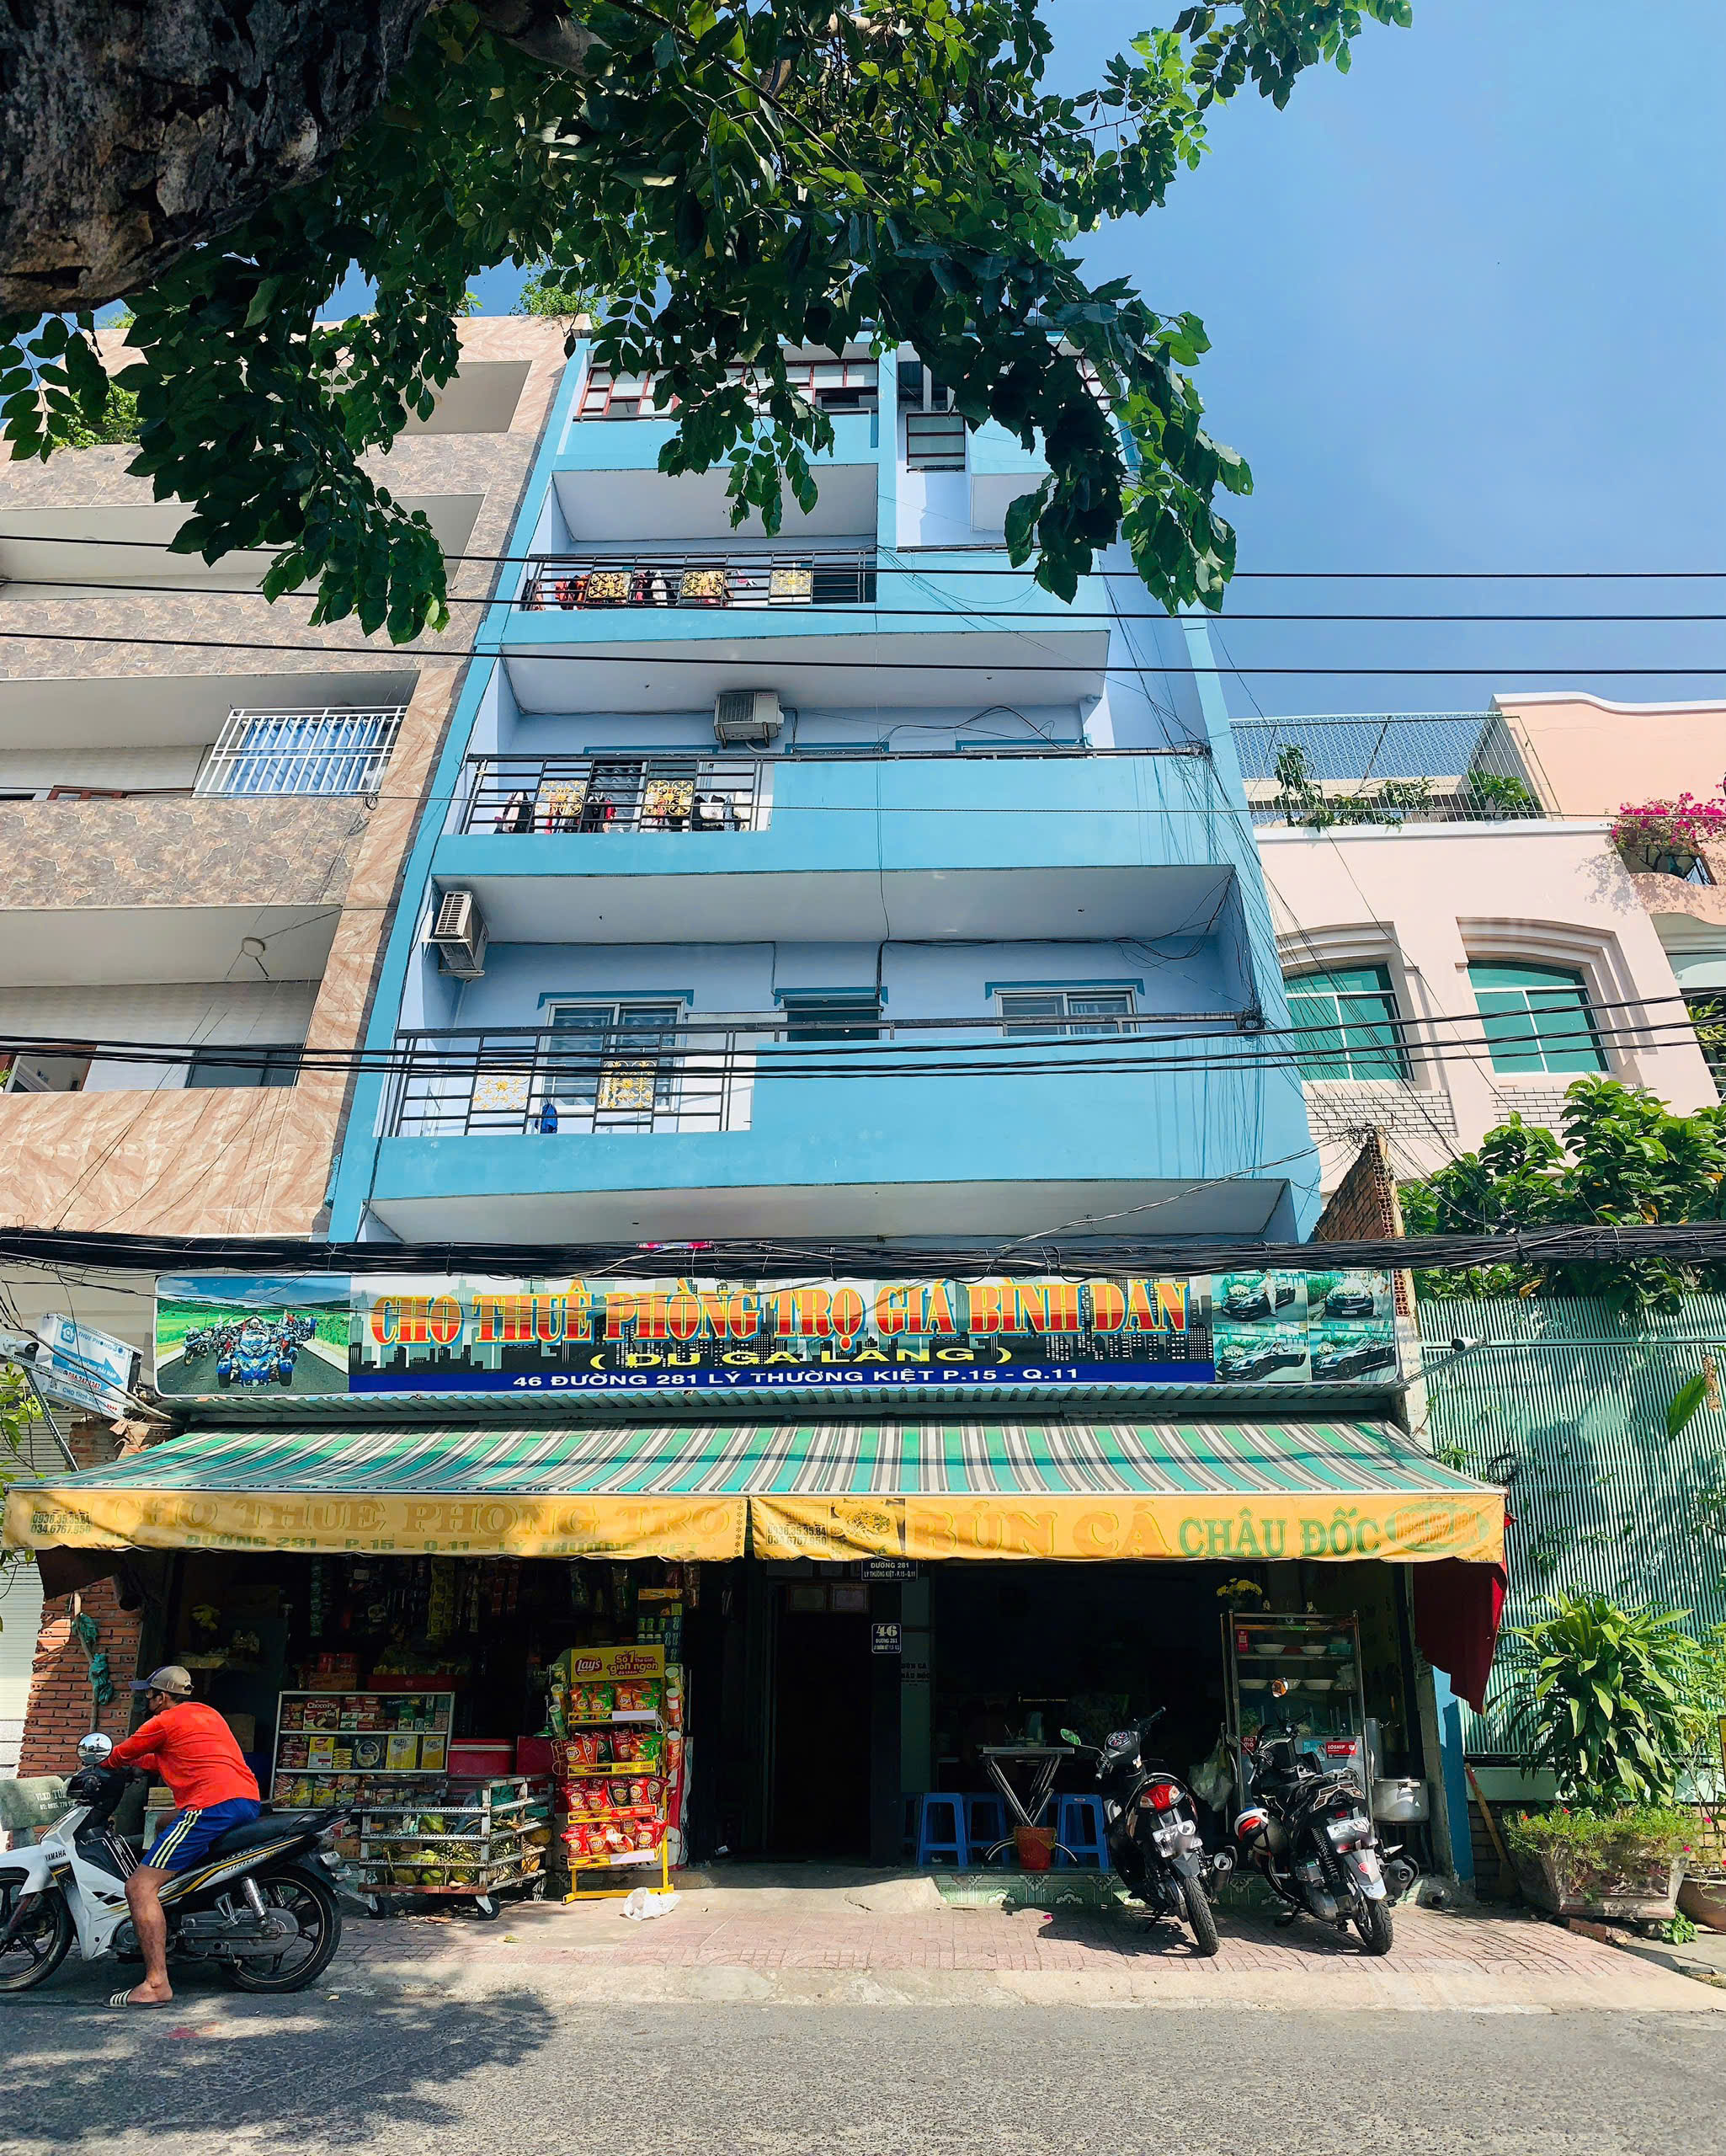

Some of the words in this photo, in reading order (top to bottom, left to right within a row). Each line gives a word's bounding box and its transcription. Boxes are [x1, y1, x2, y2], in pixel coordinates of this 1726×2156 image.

[370, 1294, 463, 1346] CHO
[472, 1278, 594, 1343] THUÊ
[605, 1278, 761, 1342] PHÒNG
[770, 1285, 865, 1352] TRỌ
[876, 1278, 958, 1337] GIÁ
[967, 1276, 1084, 1336] BÌNH
[1092, 1279, 1189, 1335] DÂN
[722, 1351, 800, 1366] GA
[513, 1375, 541, 1387] 46
[551, 1372, 647, 1386] ĐƯỜNG
[657, 1374, 697, 1385] 281
[709, 1370, 739, 1384] LÝ
[749, 1369, 863, 1385] THƯỜNG
[874, 1369, 935, 1383] KIỆT
[944, 1369, 997, 1381] P.15
[1023, 1368, 1078, 1380] Q.11
[912, 1501, 1058, 1556] BÚN
[1072, 1500, 1173, 1556] CÁ
[1179, 1507, 1287, 1557] CHÂU
[1298, 1507, 1382, 1557] ĐỐC
[275, 1537, 317, 1549] 281
[344, 1539, 395, 1550] P.15
[876, 1625, 898, 1637] 46
[633, 1662, 658, 1673] ngon
[45, 1849, 67, 1861] YAMAHA
